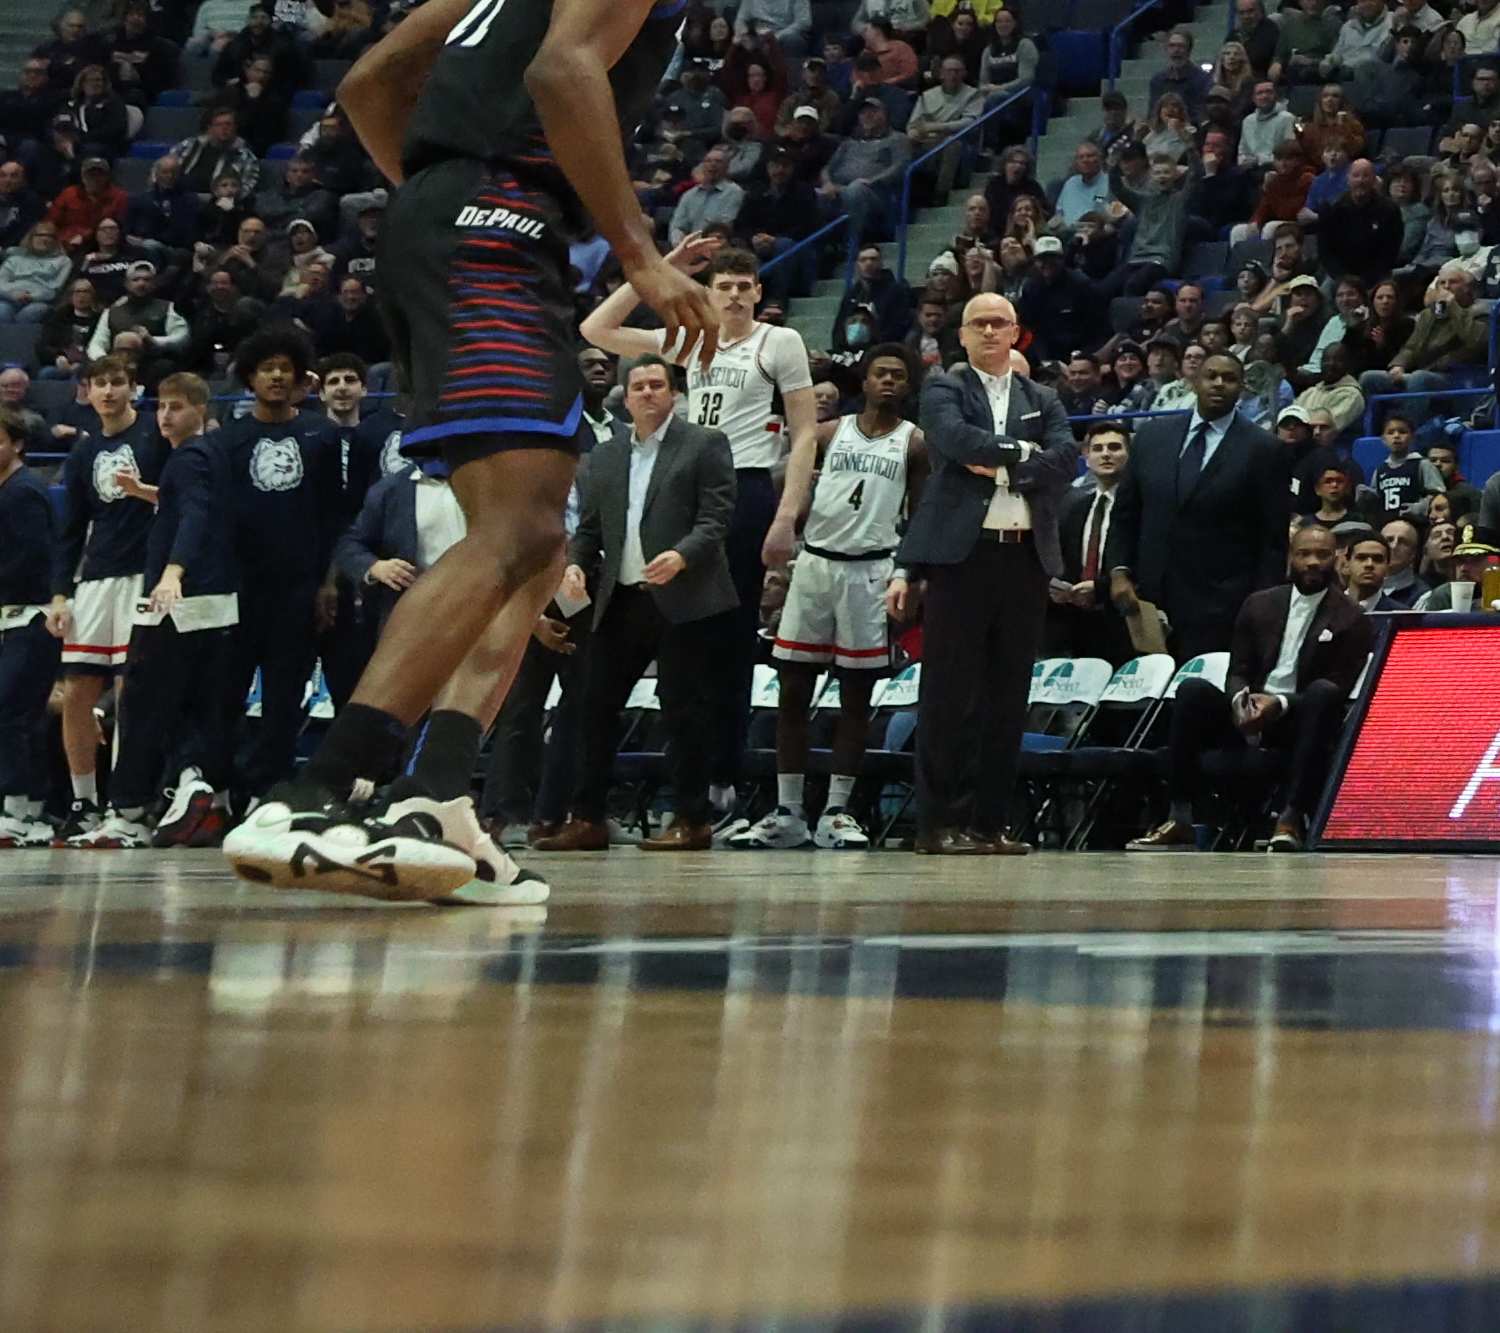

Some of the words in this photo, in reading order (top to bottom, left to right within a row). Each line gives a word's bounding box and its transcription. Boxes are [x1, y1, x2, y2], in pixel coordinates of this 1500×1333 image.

[698, 392, 723, 426] 32
[830, 451, 900, 482] CONNECTICUT
[848, 479, 866, 511] 4
[1384, 488, 1401, 511] 15
